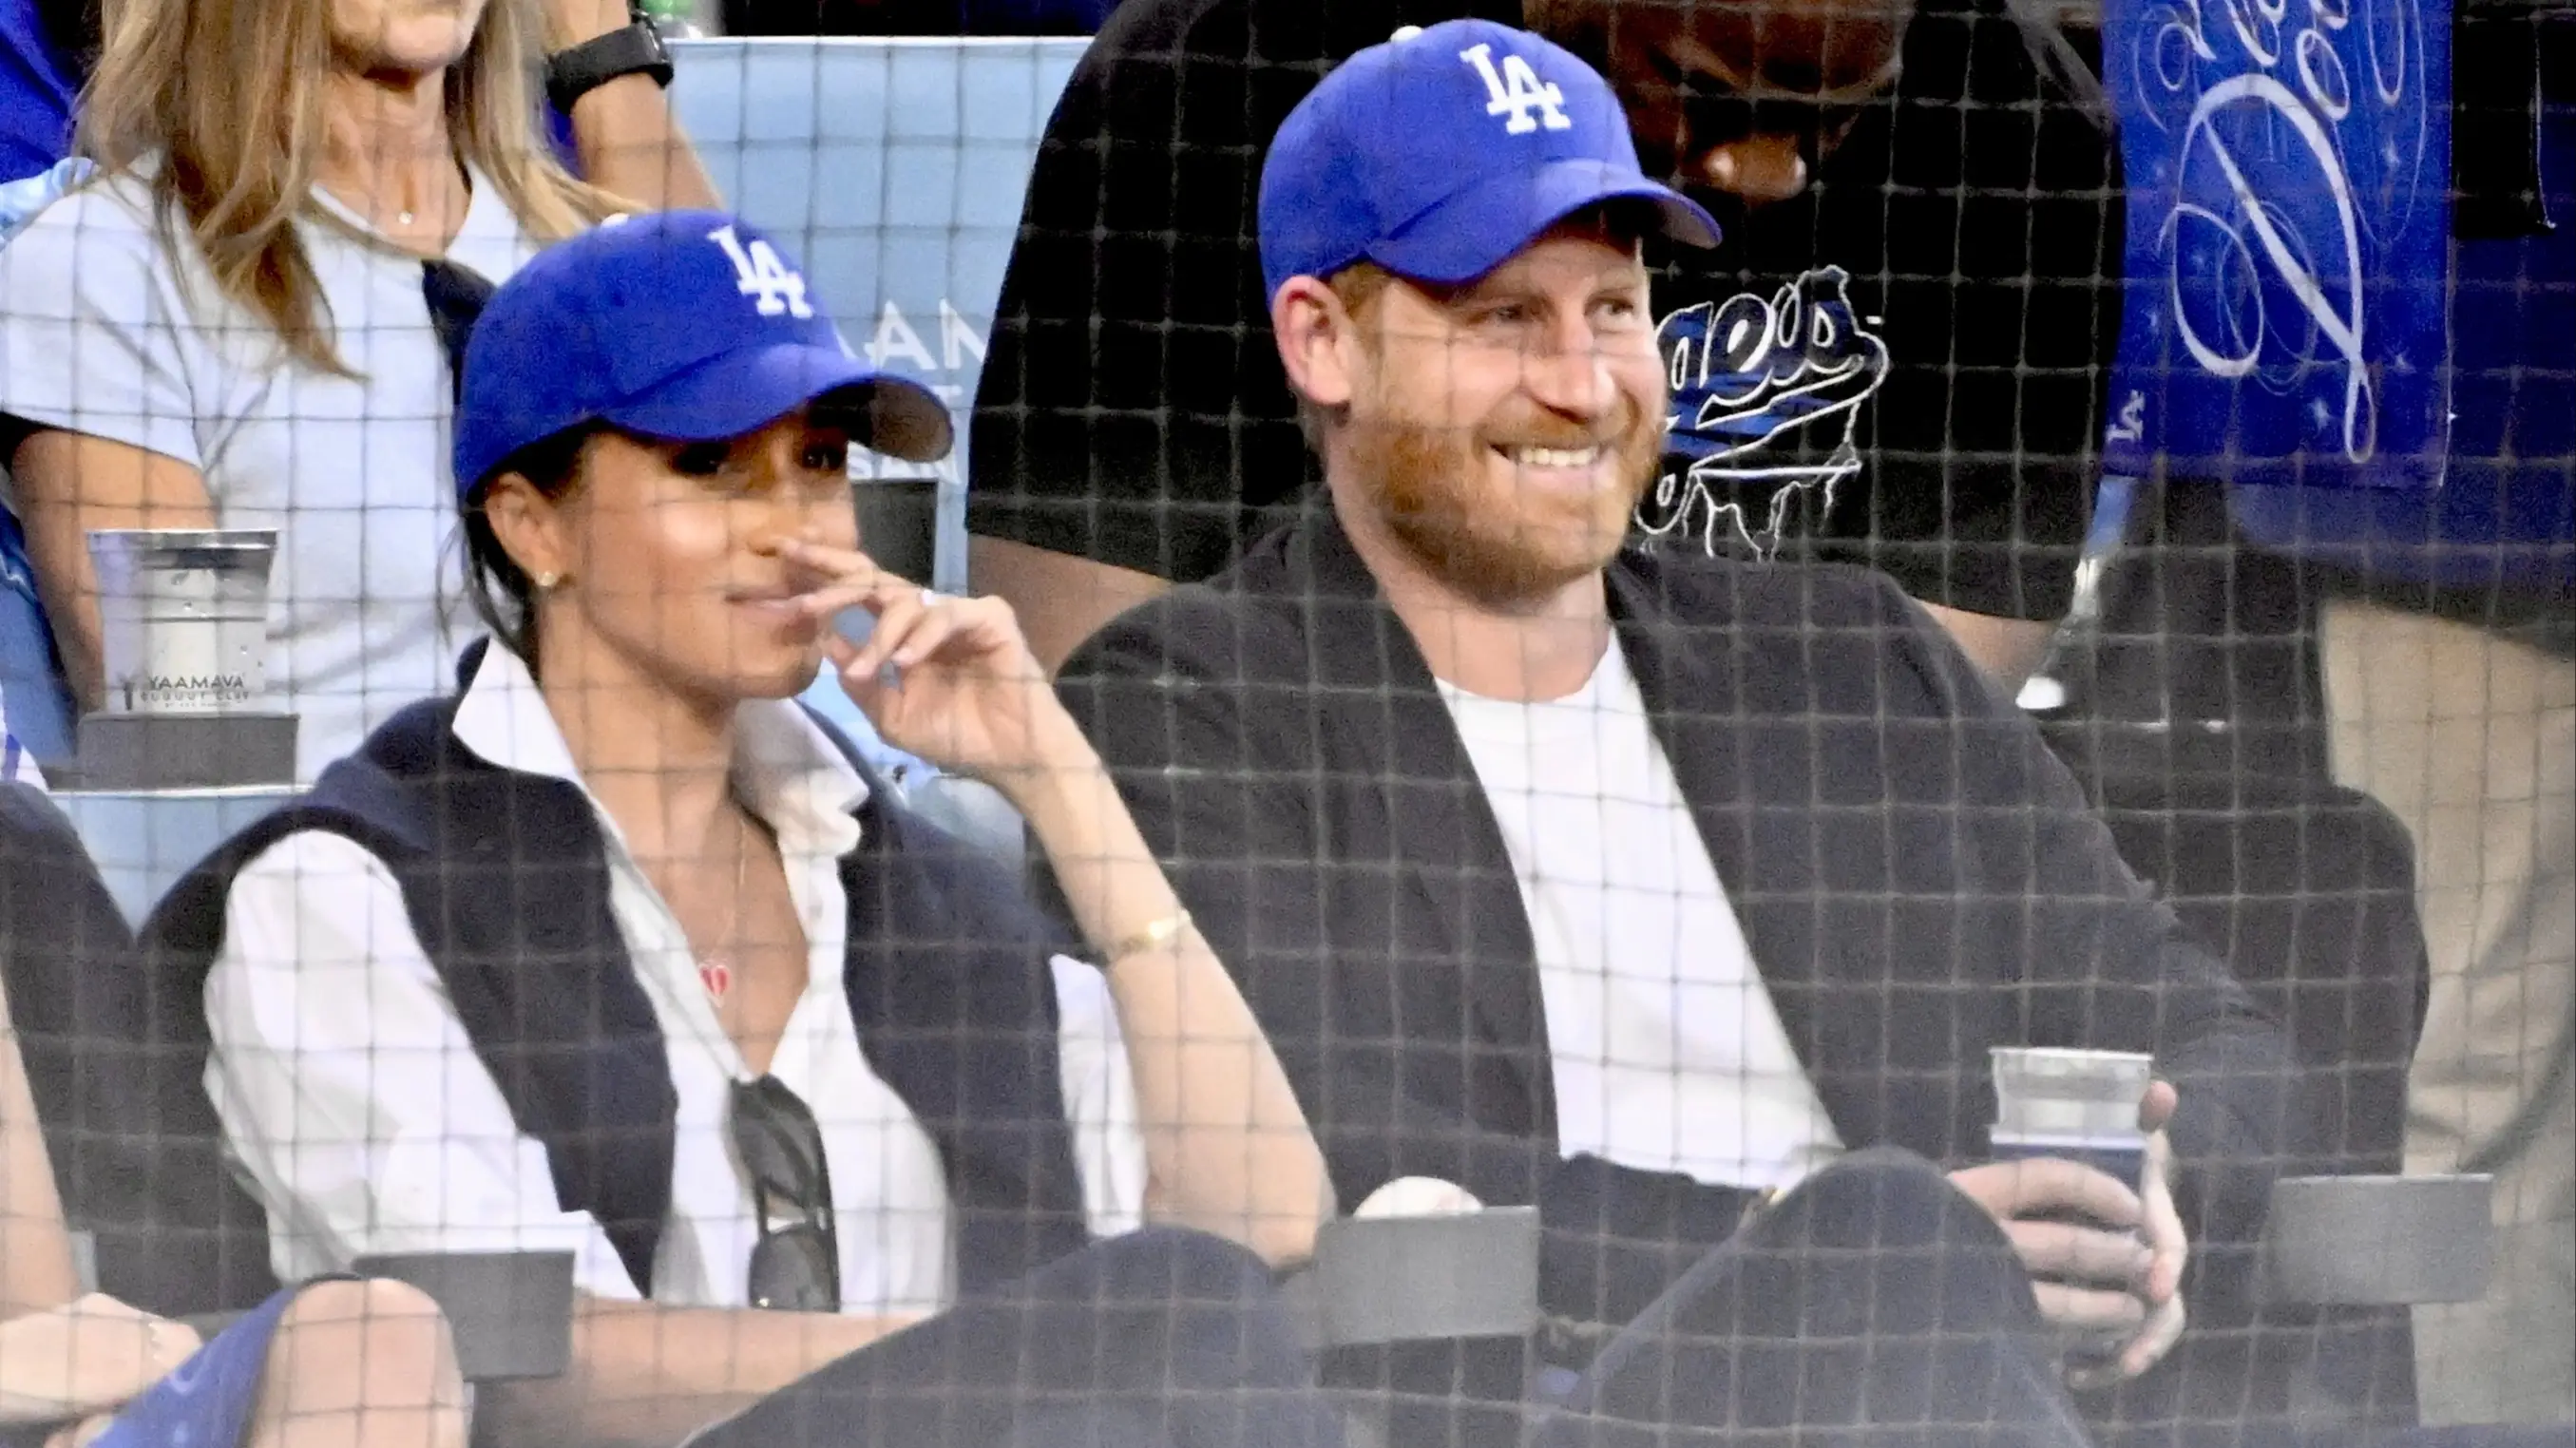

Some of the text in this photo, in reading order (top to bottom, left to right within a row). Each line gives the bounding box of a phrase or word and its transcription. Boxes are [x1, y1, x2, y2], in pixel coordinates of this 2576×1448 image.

[1459, 43, 1572, 135] LA
[707, 224, 813, 319] LA
[2105, 389, 2145, 443] LA
